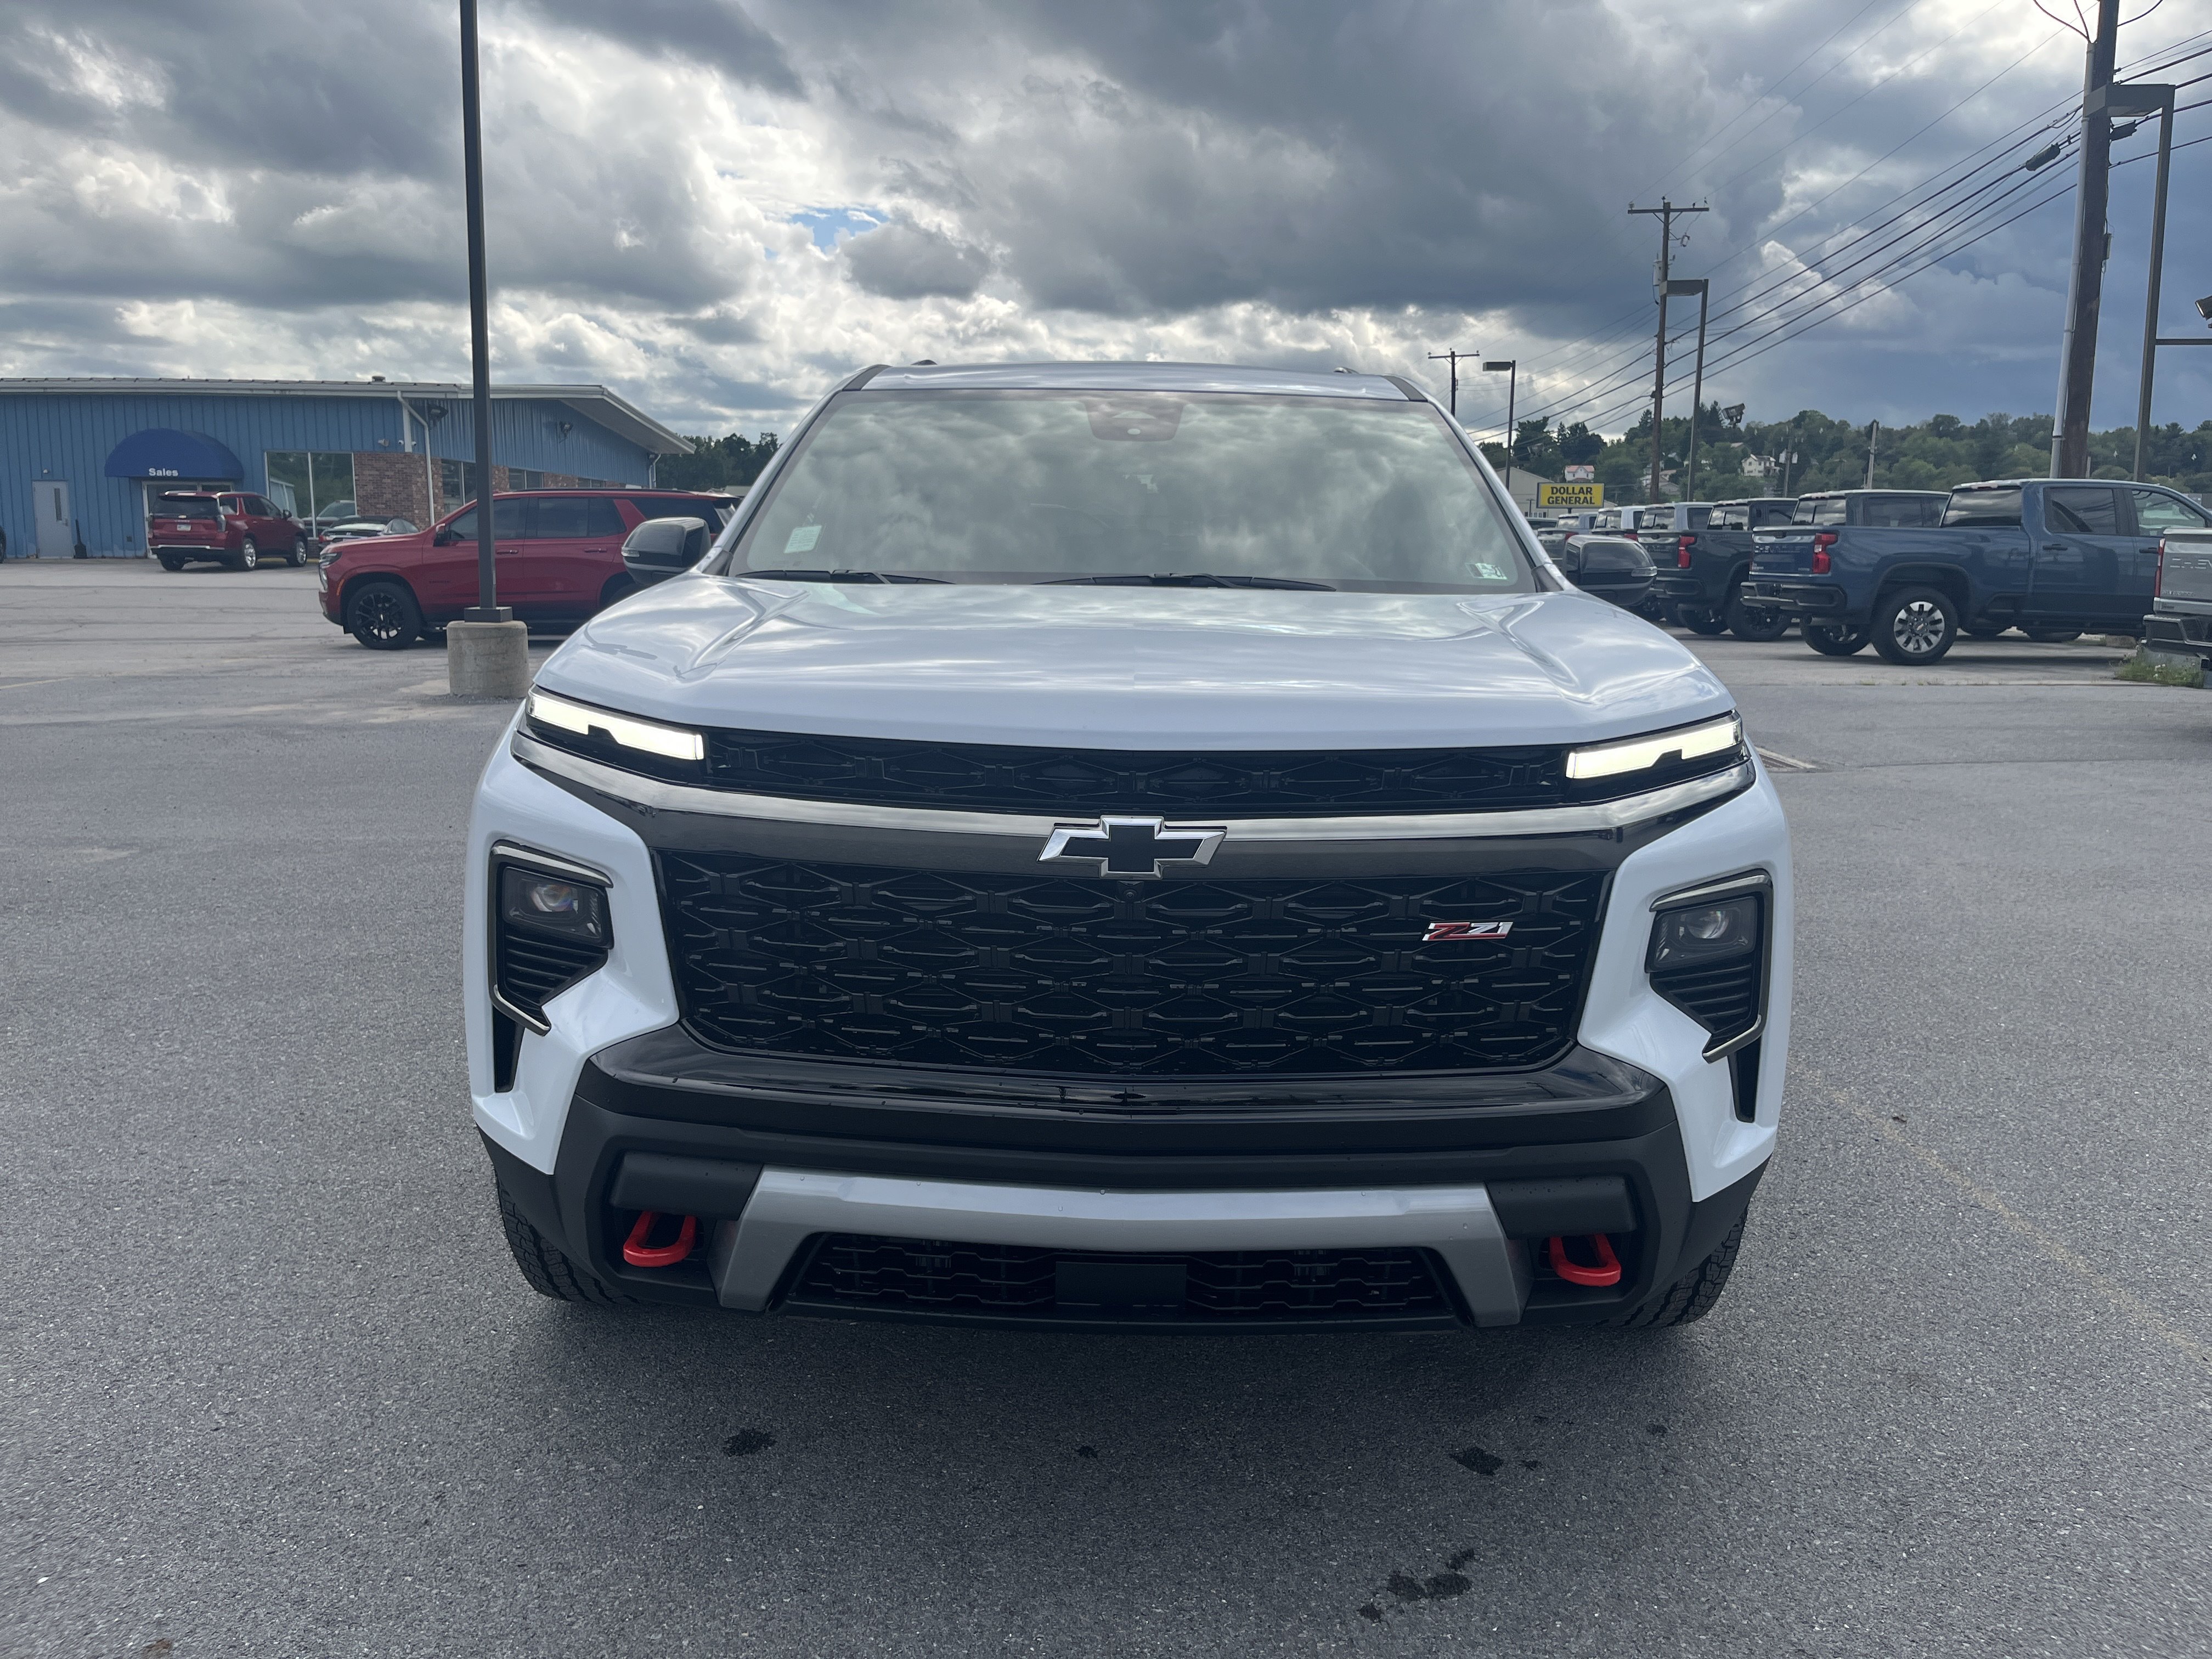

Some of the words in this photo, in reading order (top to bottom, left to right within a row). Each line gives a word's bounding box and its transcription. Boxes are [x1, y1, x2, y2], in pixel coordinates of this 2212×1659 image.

[149, 467, 178, 476] Sales
[1550, 487, 1593, 495] DOLLAR
[1547, 496, 1595, 505] GENERAL
[1422, 922, 1514, 941] Z71
